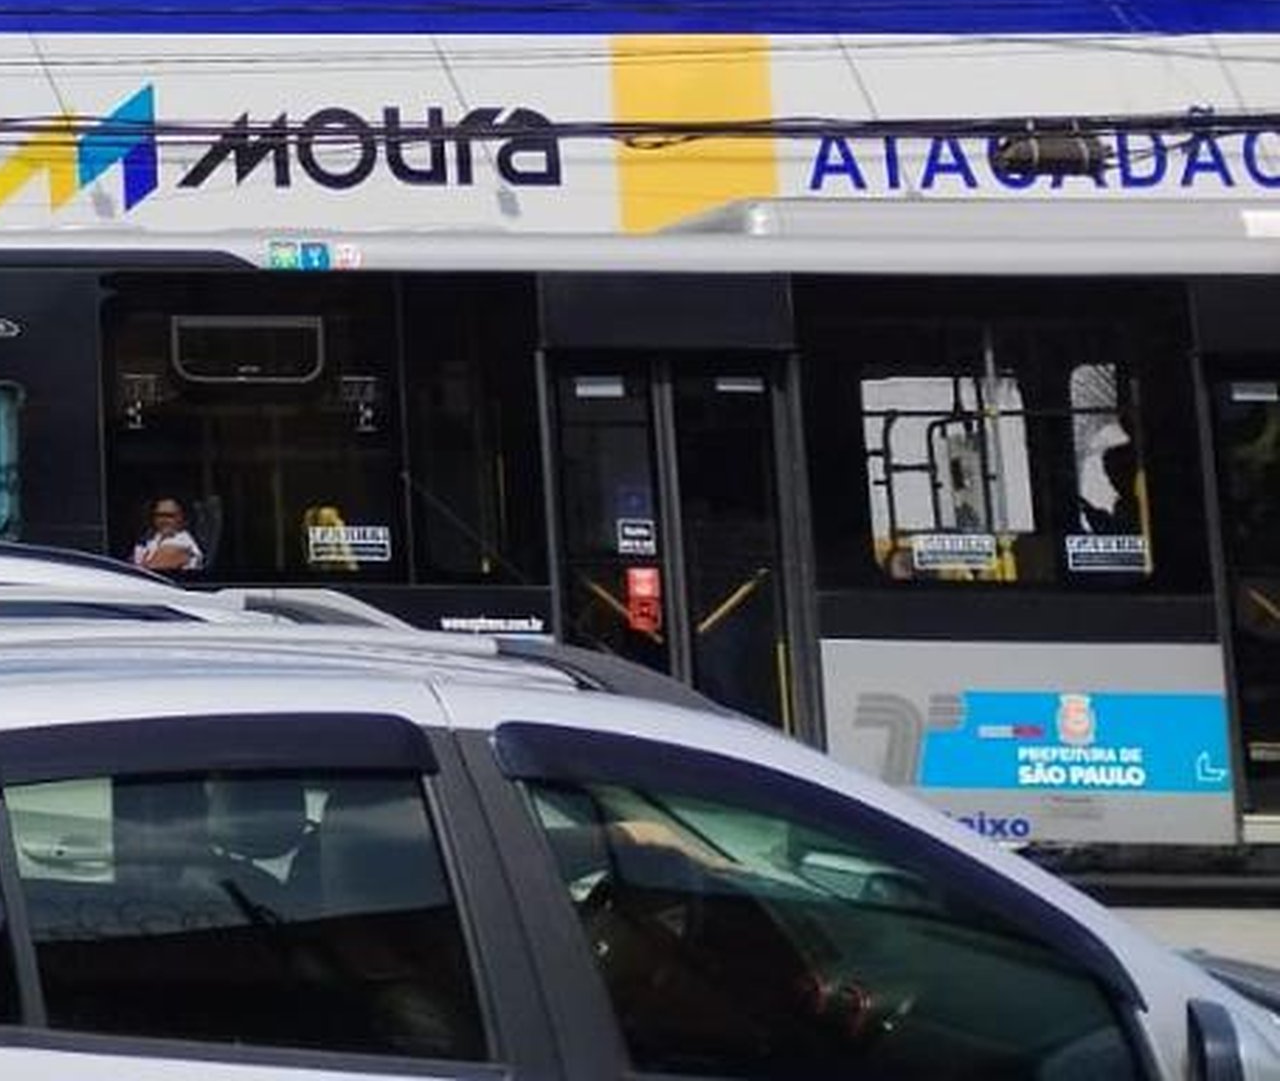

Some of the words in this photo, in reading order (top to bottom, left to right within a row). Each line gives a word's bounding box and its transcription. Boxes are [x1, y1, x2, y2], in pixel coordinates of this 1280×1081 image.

[1017, 746, 1117, 763] PREFEITURA
[1119, 747, 1143, 763] DE
[1017, 764, 1067, 785] SÃO
[1070, 765, 1146, 787] PAULO
